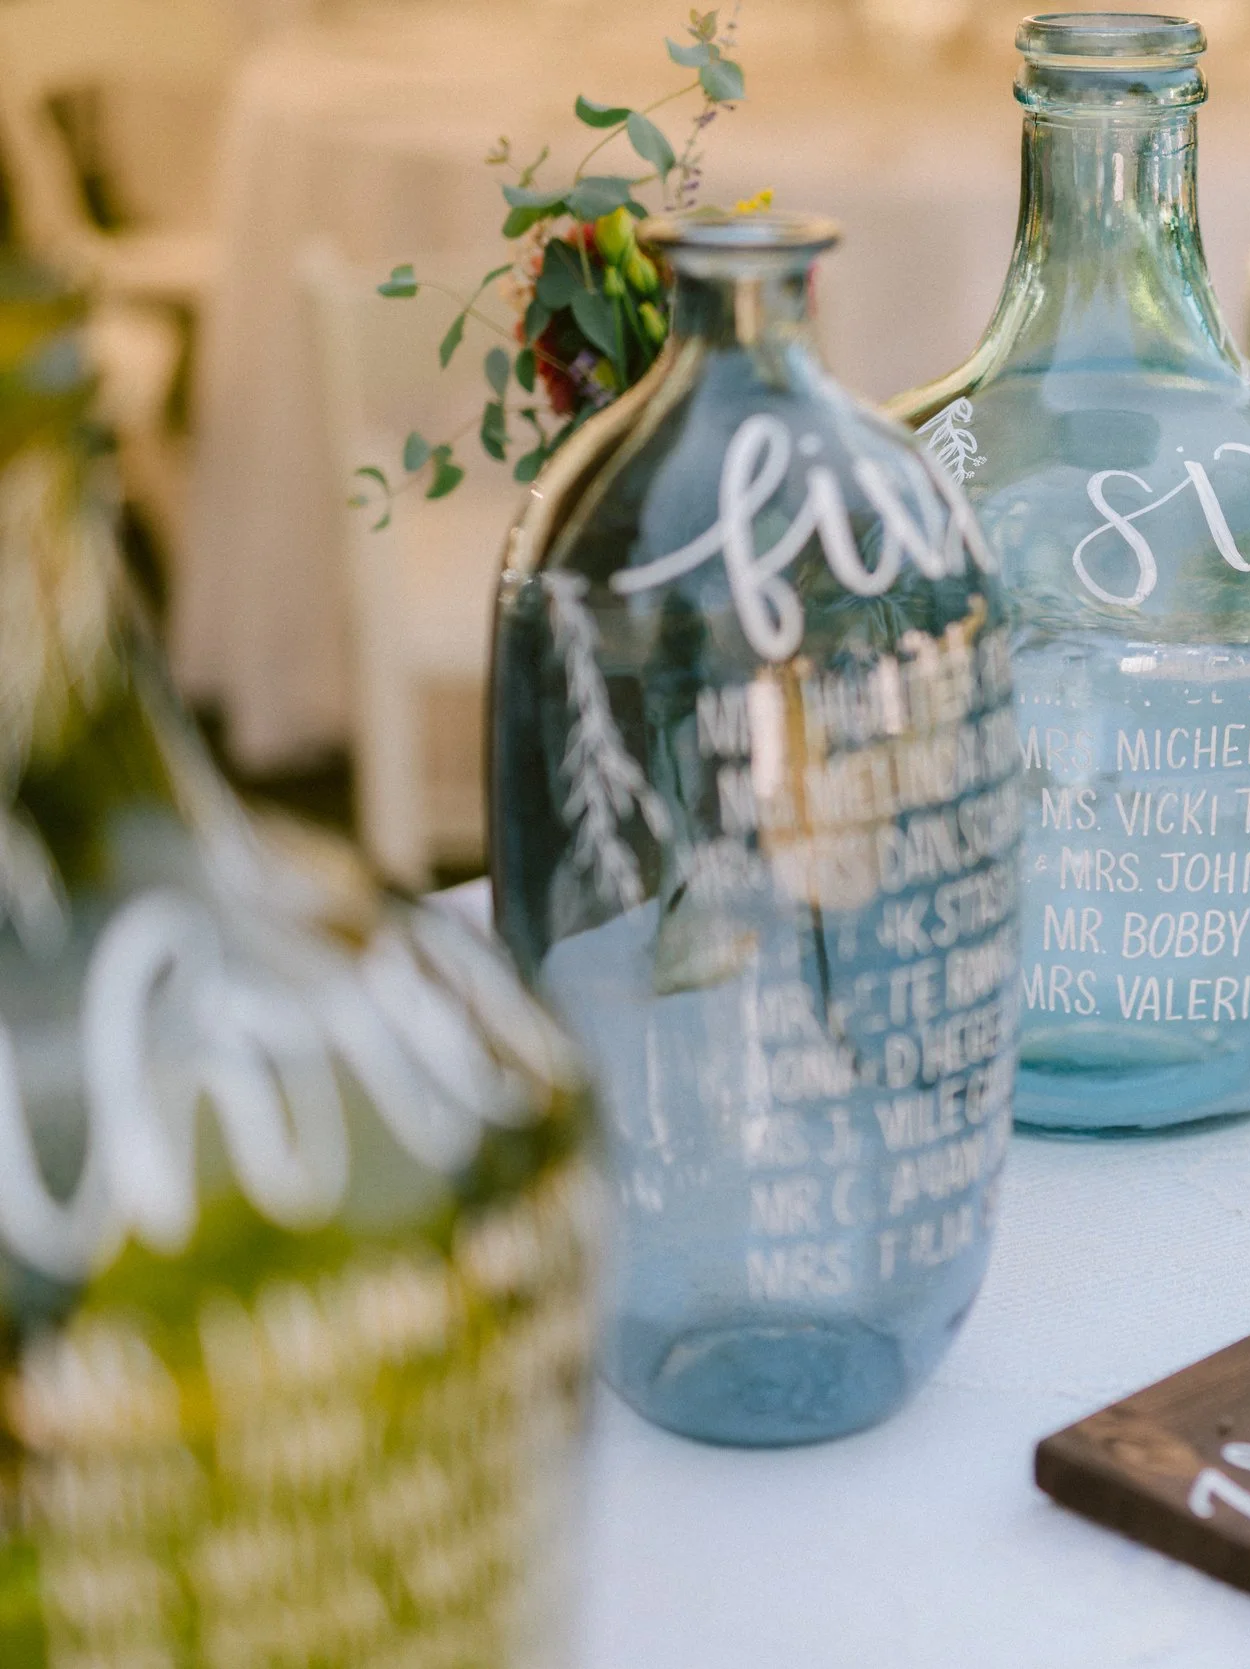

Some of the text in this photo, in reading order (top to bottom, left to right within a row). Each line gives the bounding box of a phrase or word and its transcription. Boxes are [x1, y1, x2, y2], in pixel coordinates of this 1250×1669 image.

[608, 412, 999, 661] fiv
[1041, 787, 1101, 831] MS.
[1114, 789, 1218, 837] VICKI
[1059, 846, 1144, 892] MRS.
[1042, 904, 1107, 955] MR.
